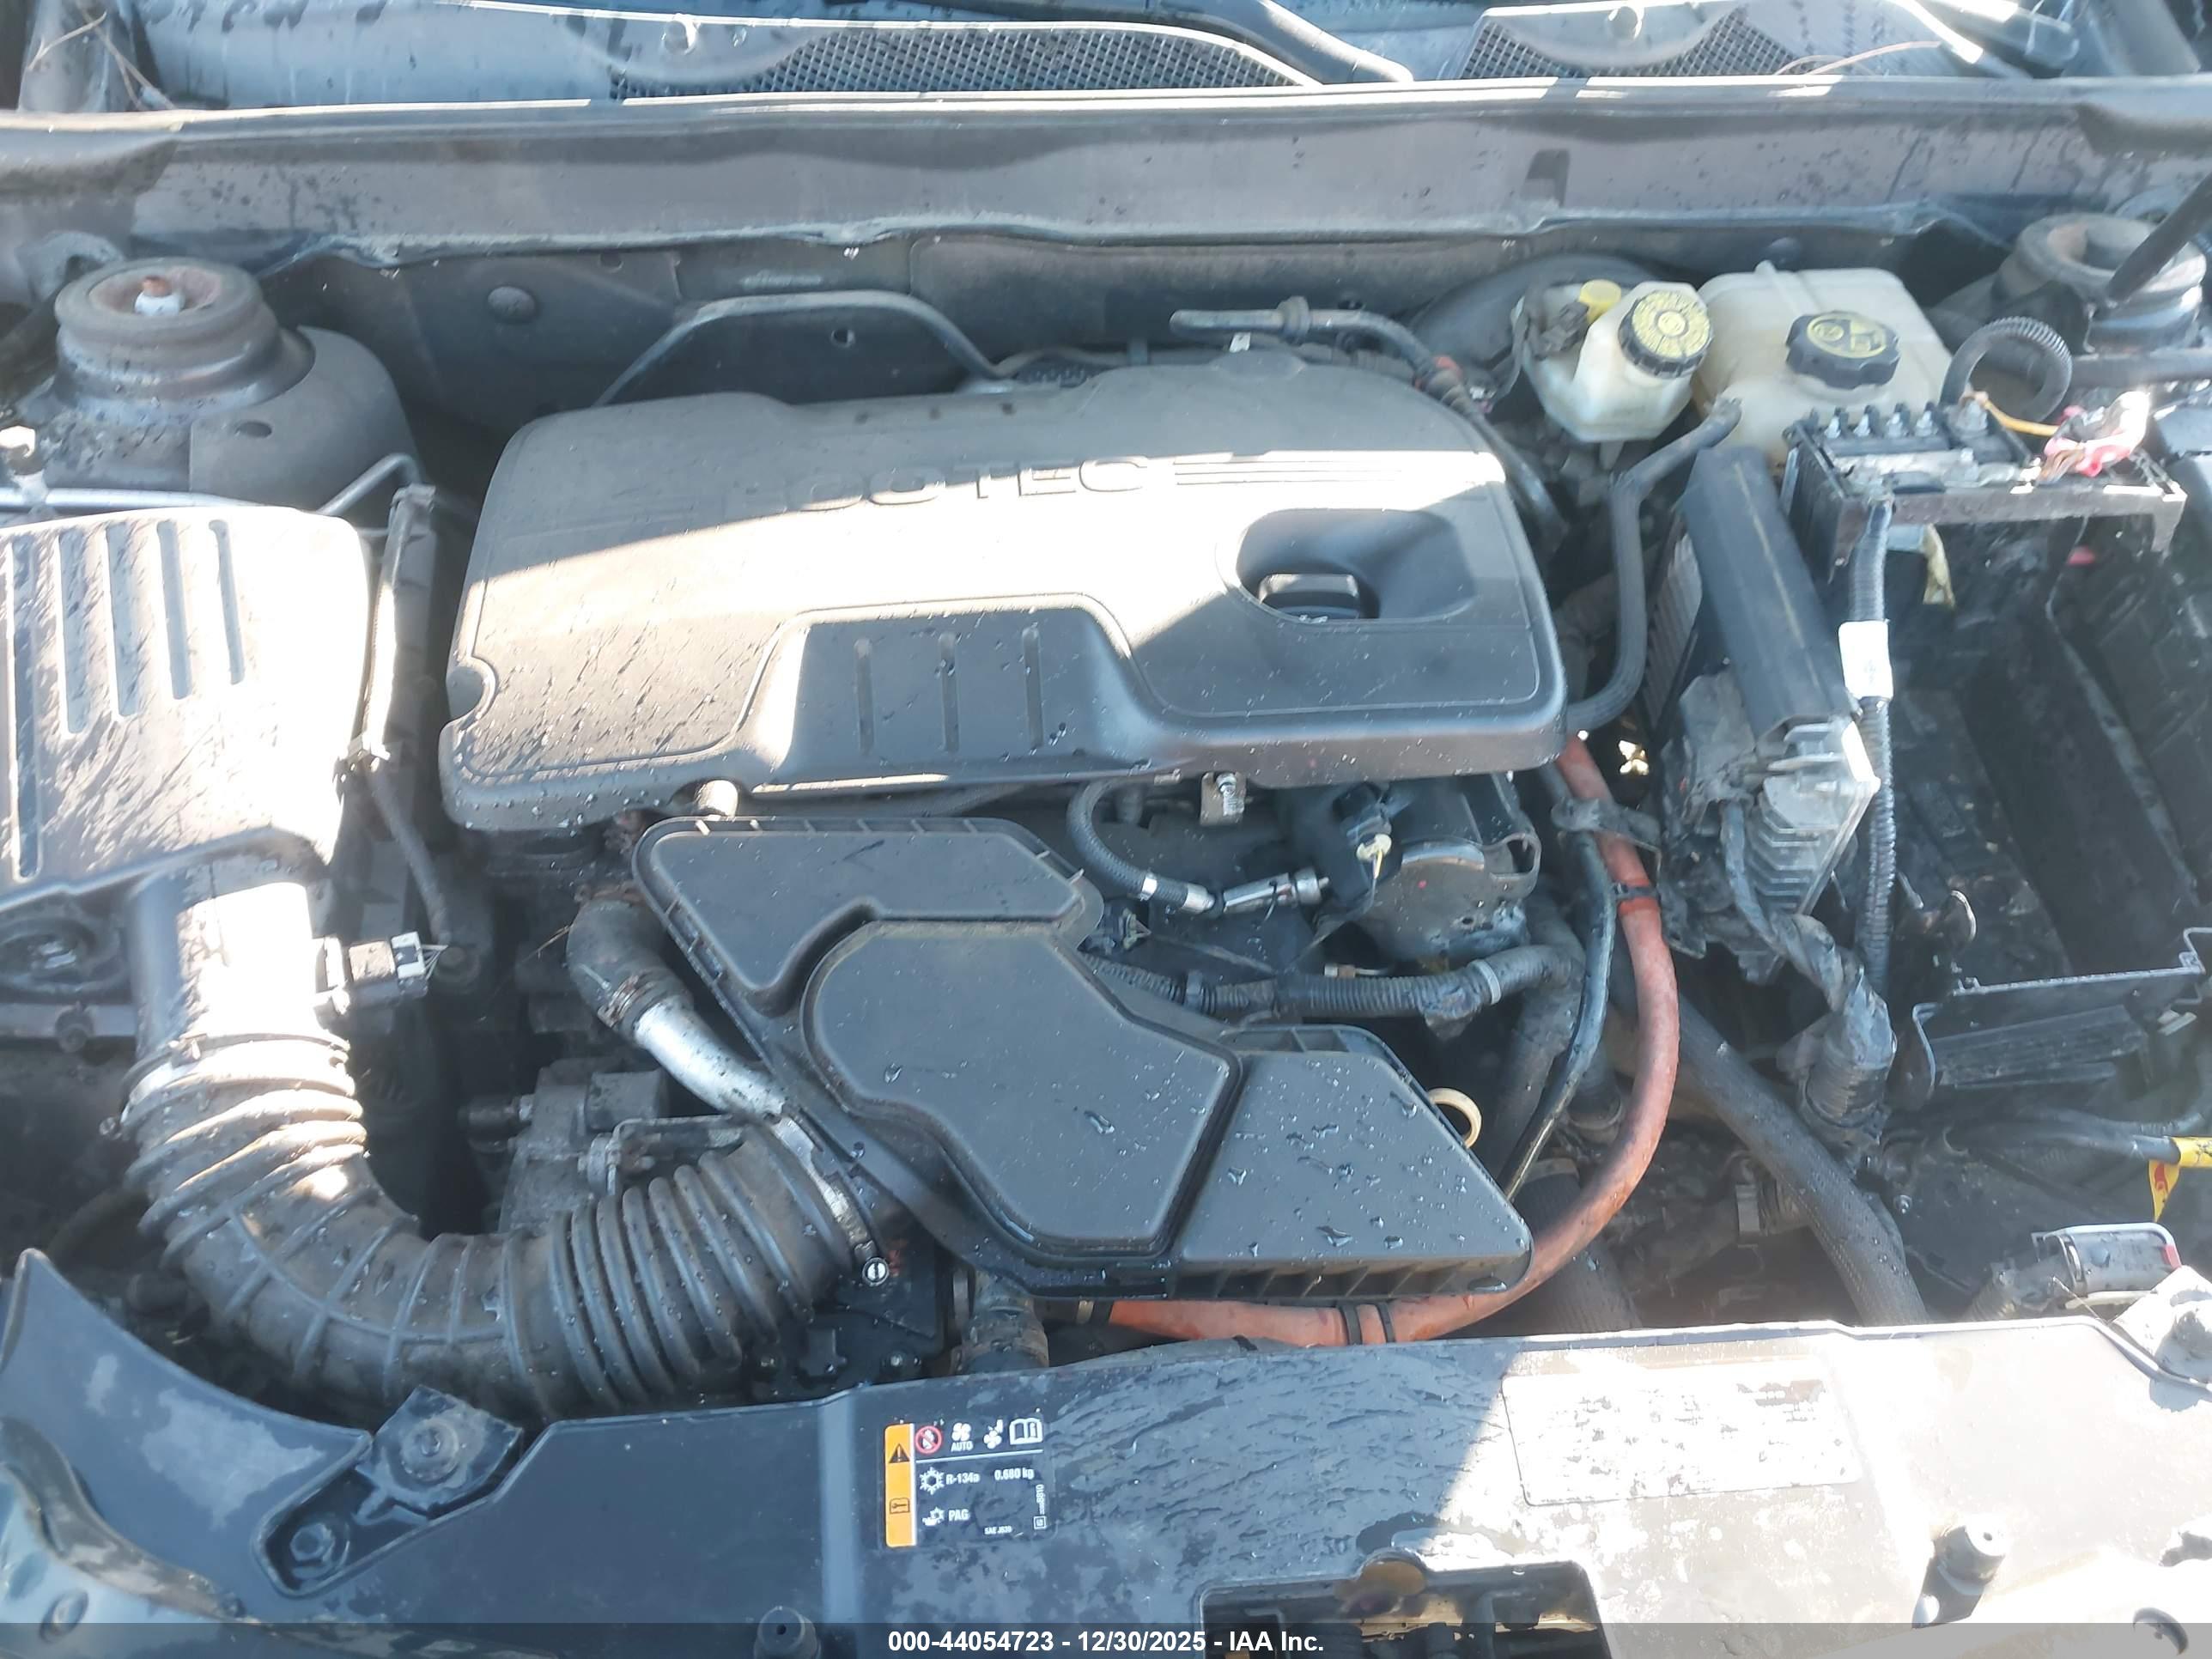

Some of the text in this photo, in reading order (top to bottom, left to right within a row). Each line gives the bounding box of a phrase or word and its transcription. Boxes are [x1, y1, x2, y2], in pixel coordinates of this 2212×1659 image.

[951, 1440, 974, 1452] AUTO
[945, 1472, 981, 1485] R-134a
[1022, 1467, 1035, 1480] kg
[948, 1509, 970, 1522] PAG
